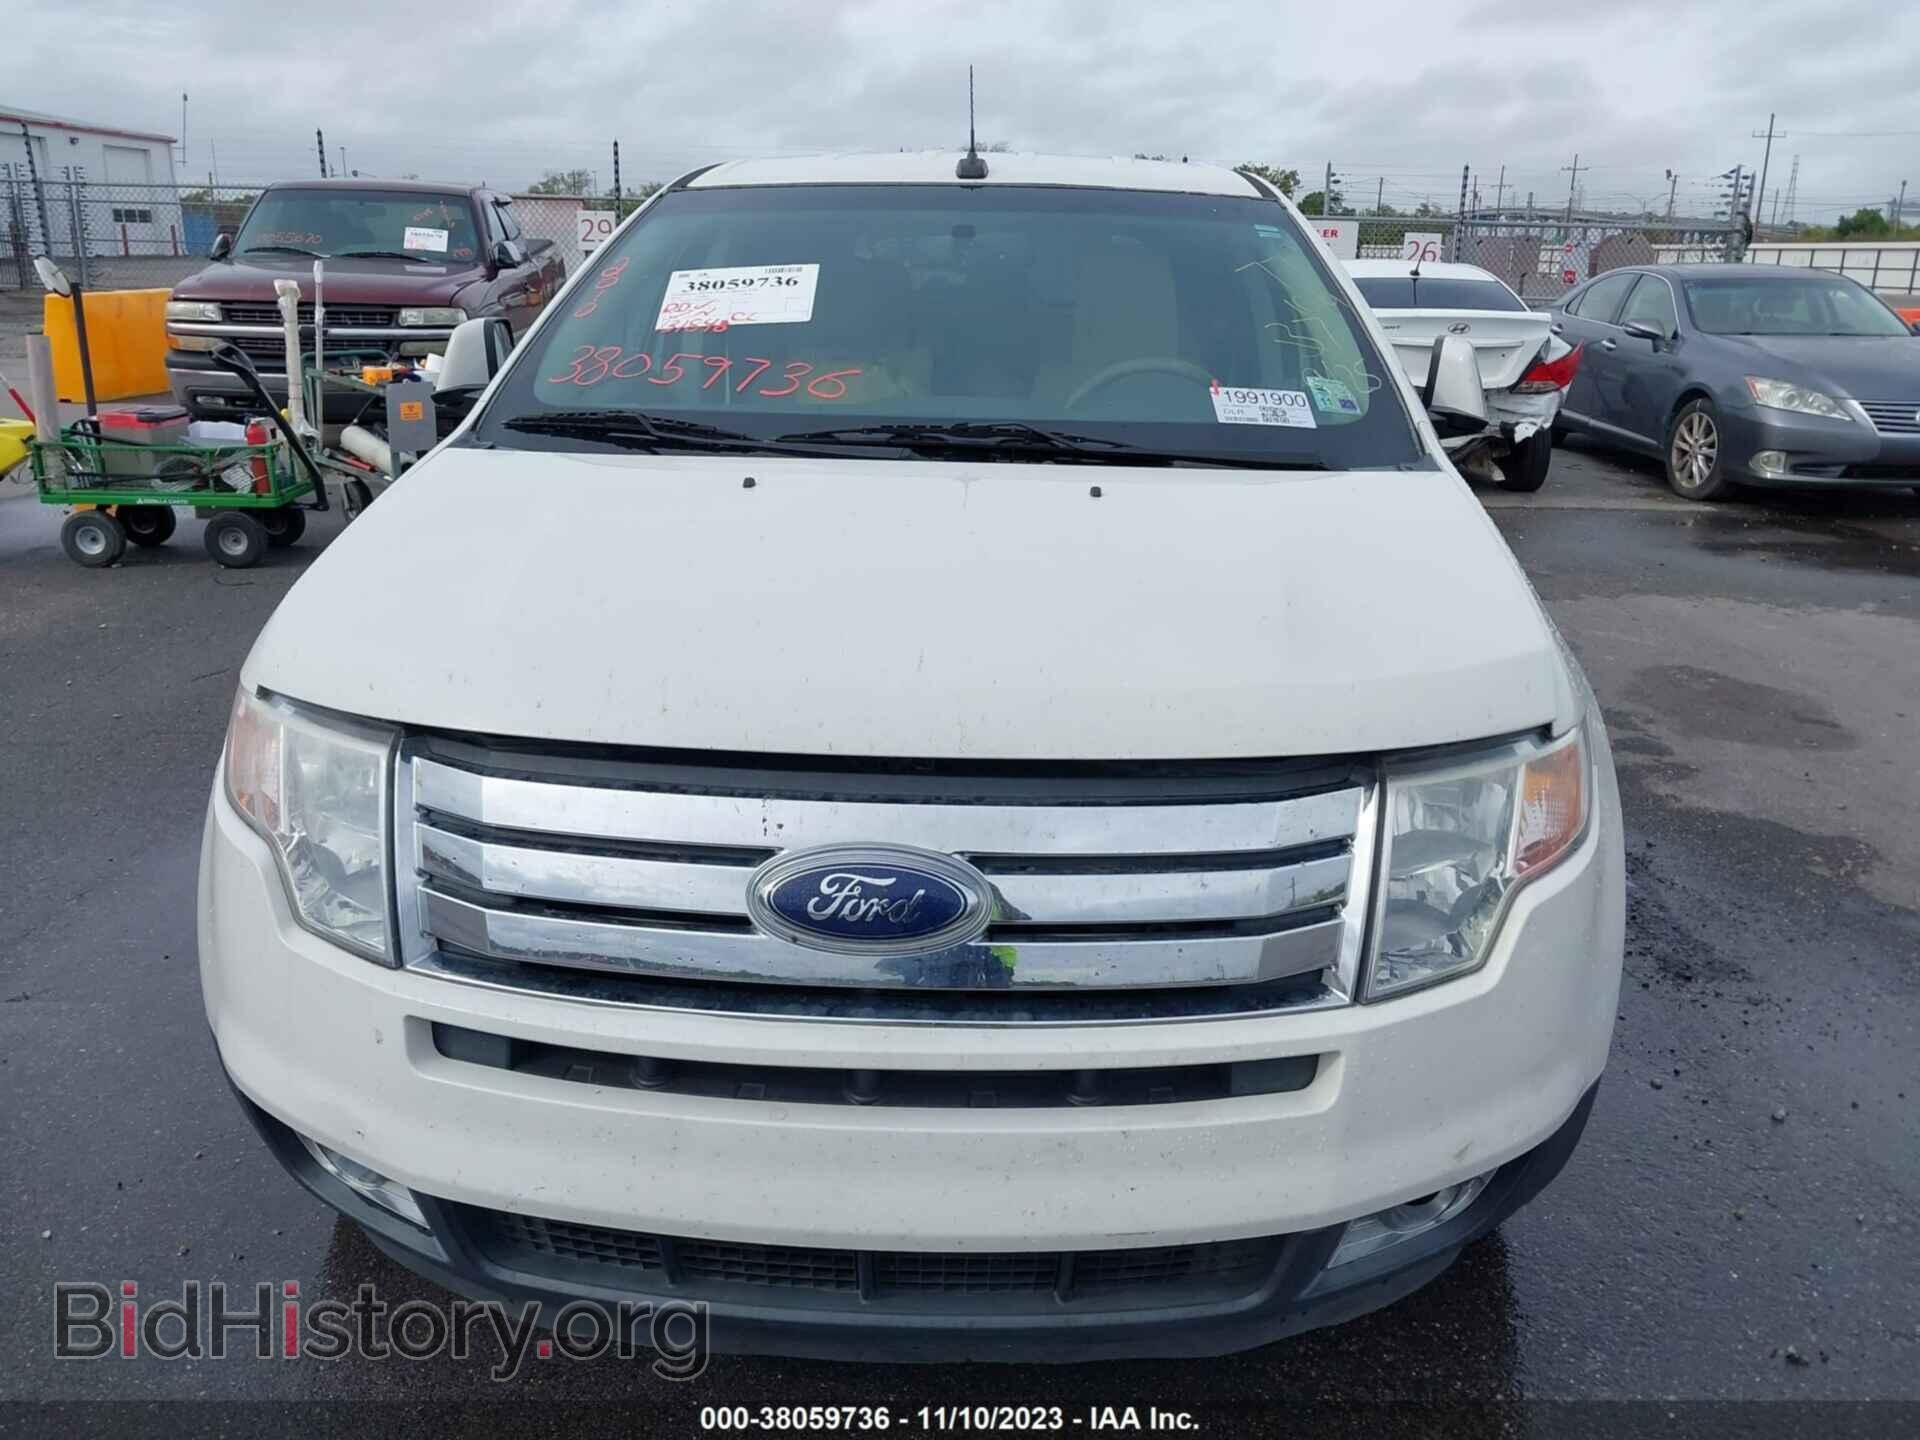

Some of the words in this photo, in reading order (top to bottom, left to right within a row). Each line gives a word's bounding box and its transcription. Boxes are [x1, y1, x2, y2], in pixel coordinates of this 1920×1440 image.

[581, 218, 612, 242] 29
[1316, 227, 1339, 238] ER
[1407, 240, 1438, 262] 26
[682, 276, 799, 293] 38059736
[548, 346, 862, 399] 38059736
[1224, 390, 1307, 408] 1991900
[806, 872, 926, 923] Ford
